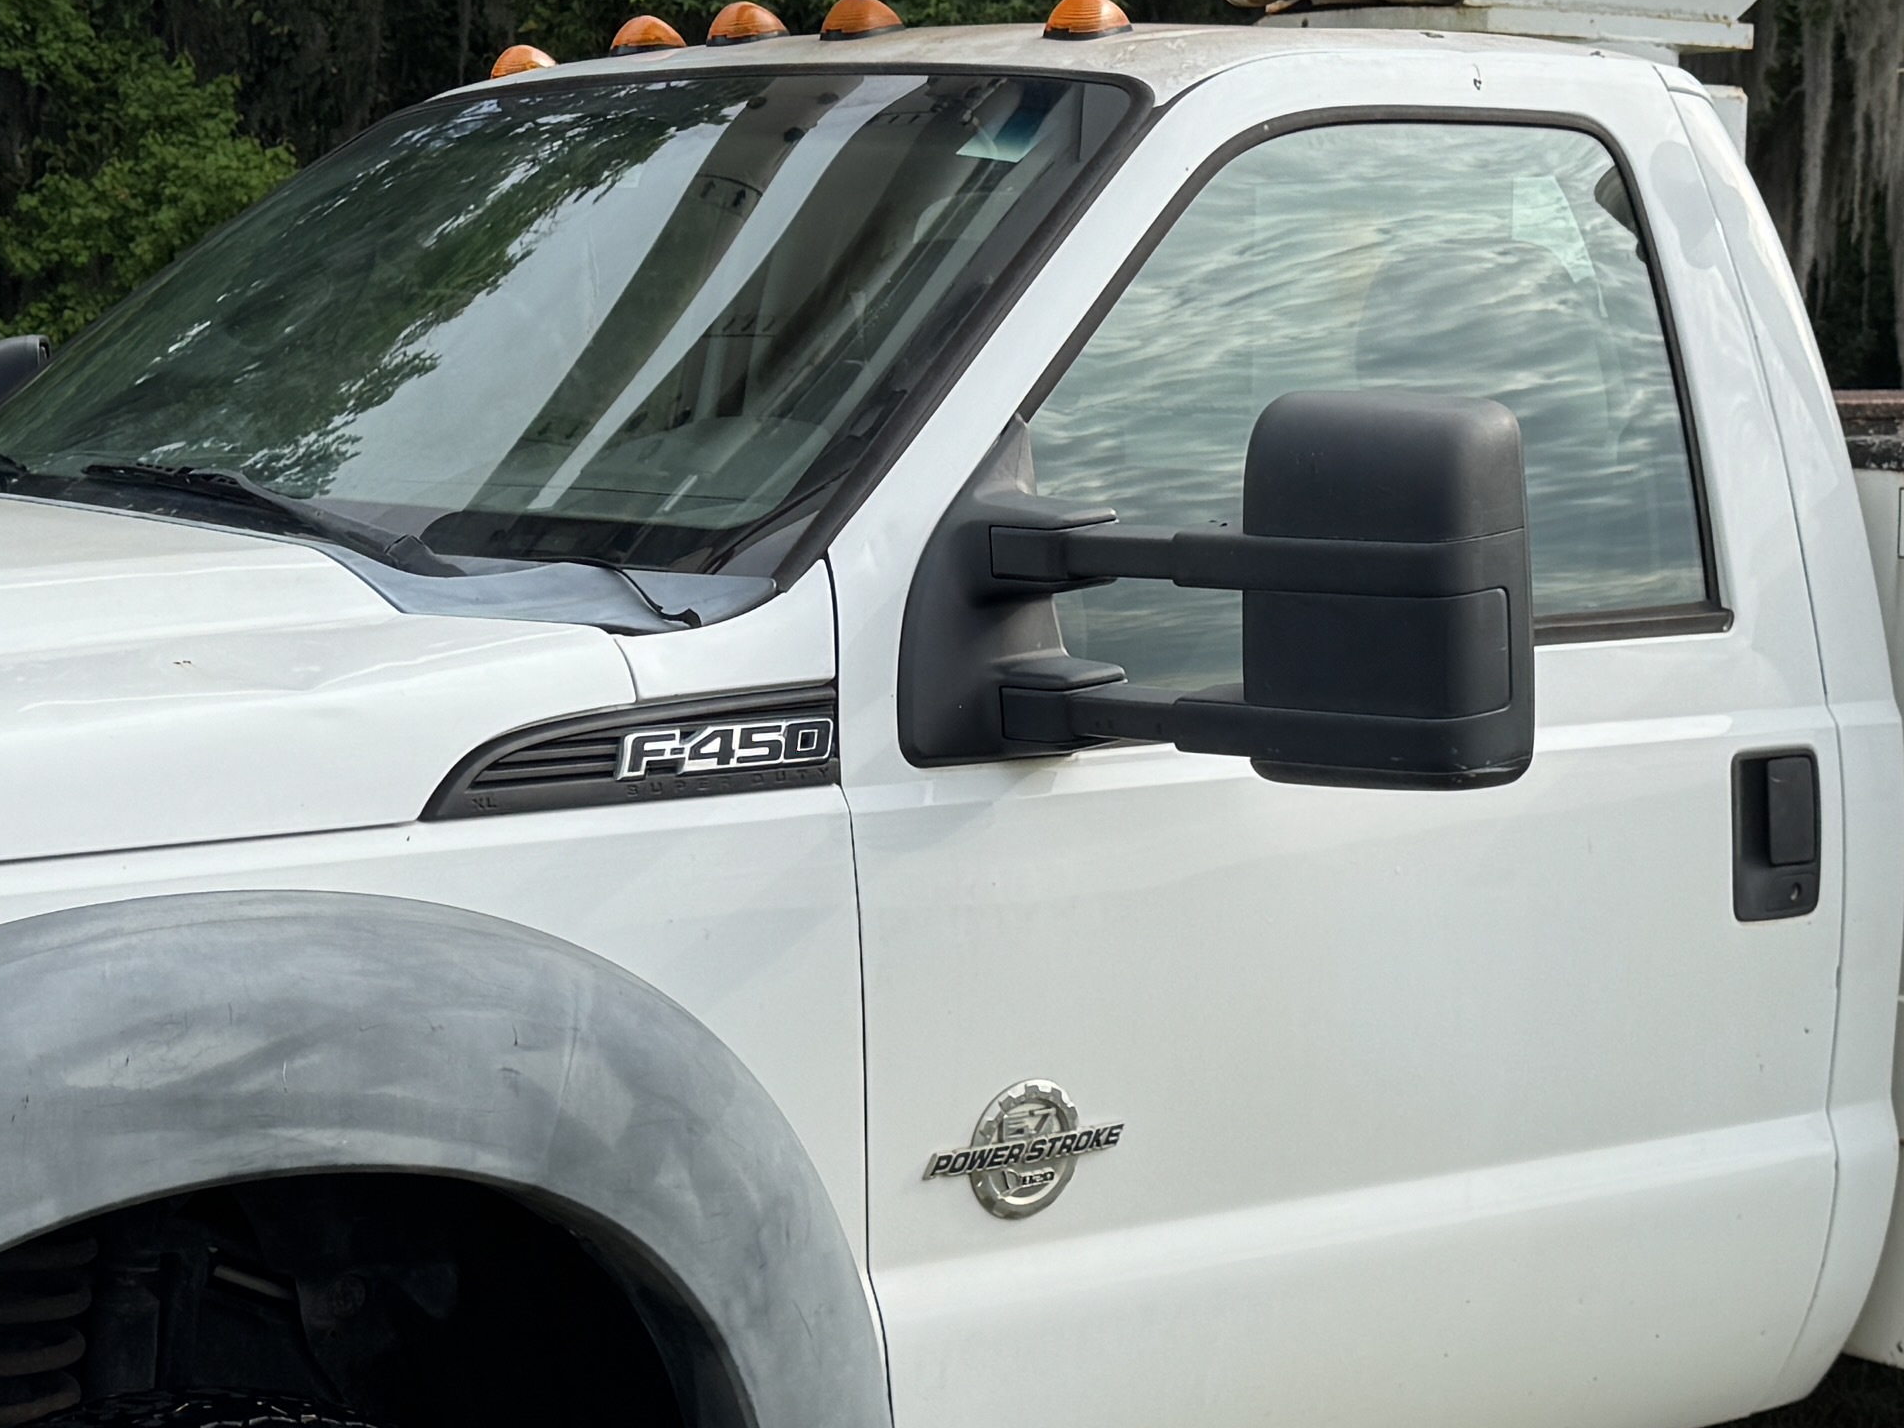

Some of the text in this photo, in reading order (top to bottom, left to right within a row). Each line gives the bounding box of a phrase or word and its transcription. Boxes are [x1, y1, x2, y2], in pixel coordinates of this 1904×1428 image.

[614, 717, 834, 781] F-450
[625, 767, 830, 798] SUPER DUTY
[925, 1122, 1125, 1177] POWER STROKE
